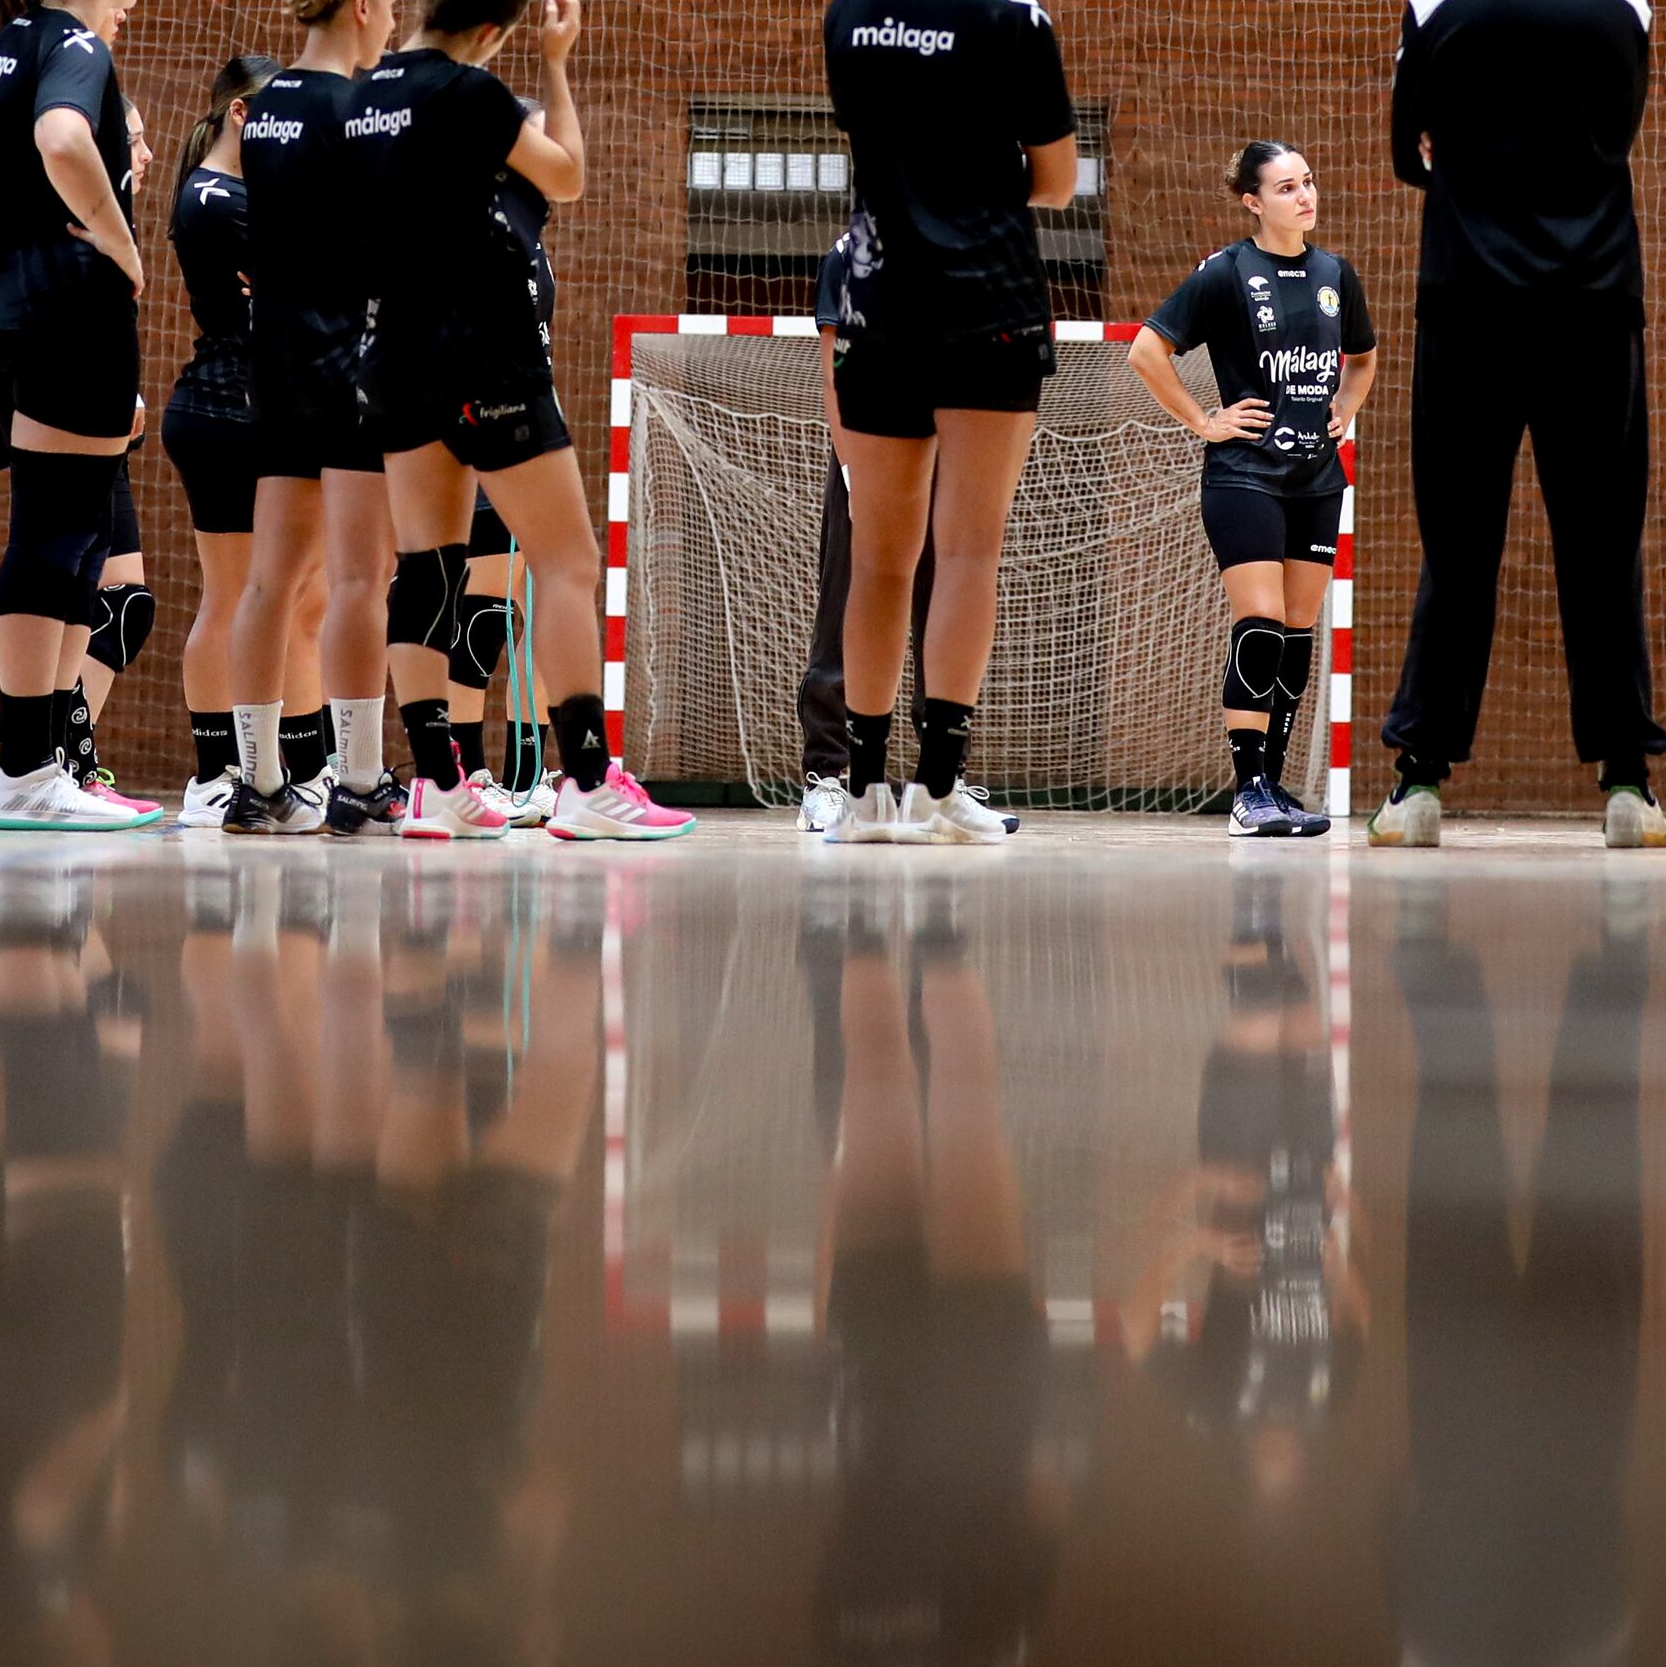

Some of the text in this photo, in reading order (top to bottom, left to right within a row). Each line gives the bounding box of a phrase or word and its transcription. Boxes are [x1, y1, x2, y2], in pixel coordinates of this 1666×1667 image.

[1259, 345, 1338, 383] Málaga
[1297, 385, 1329, 395] MODA
[239, 711, 257, 785] SALMING
[335, 708, 353, 775] SALMING
